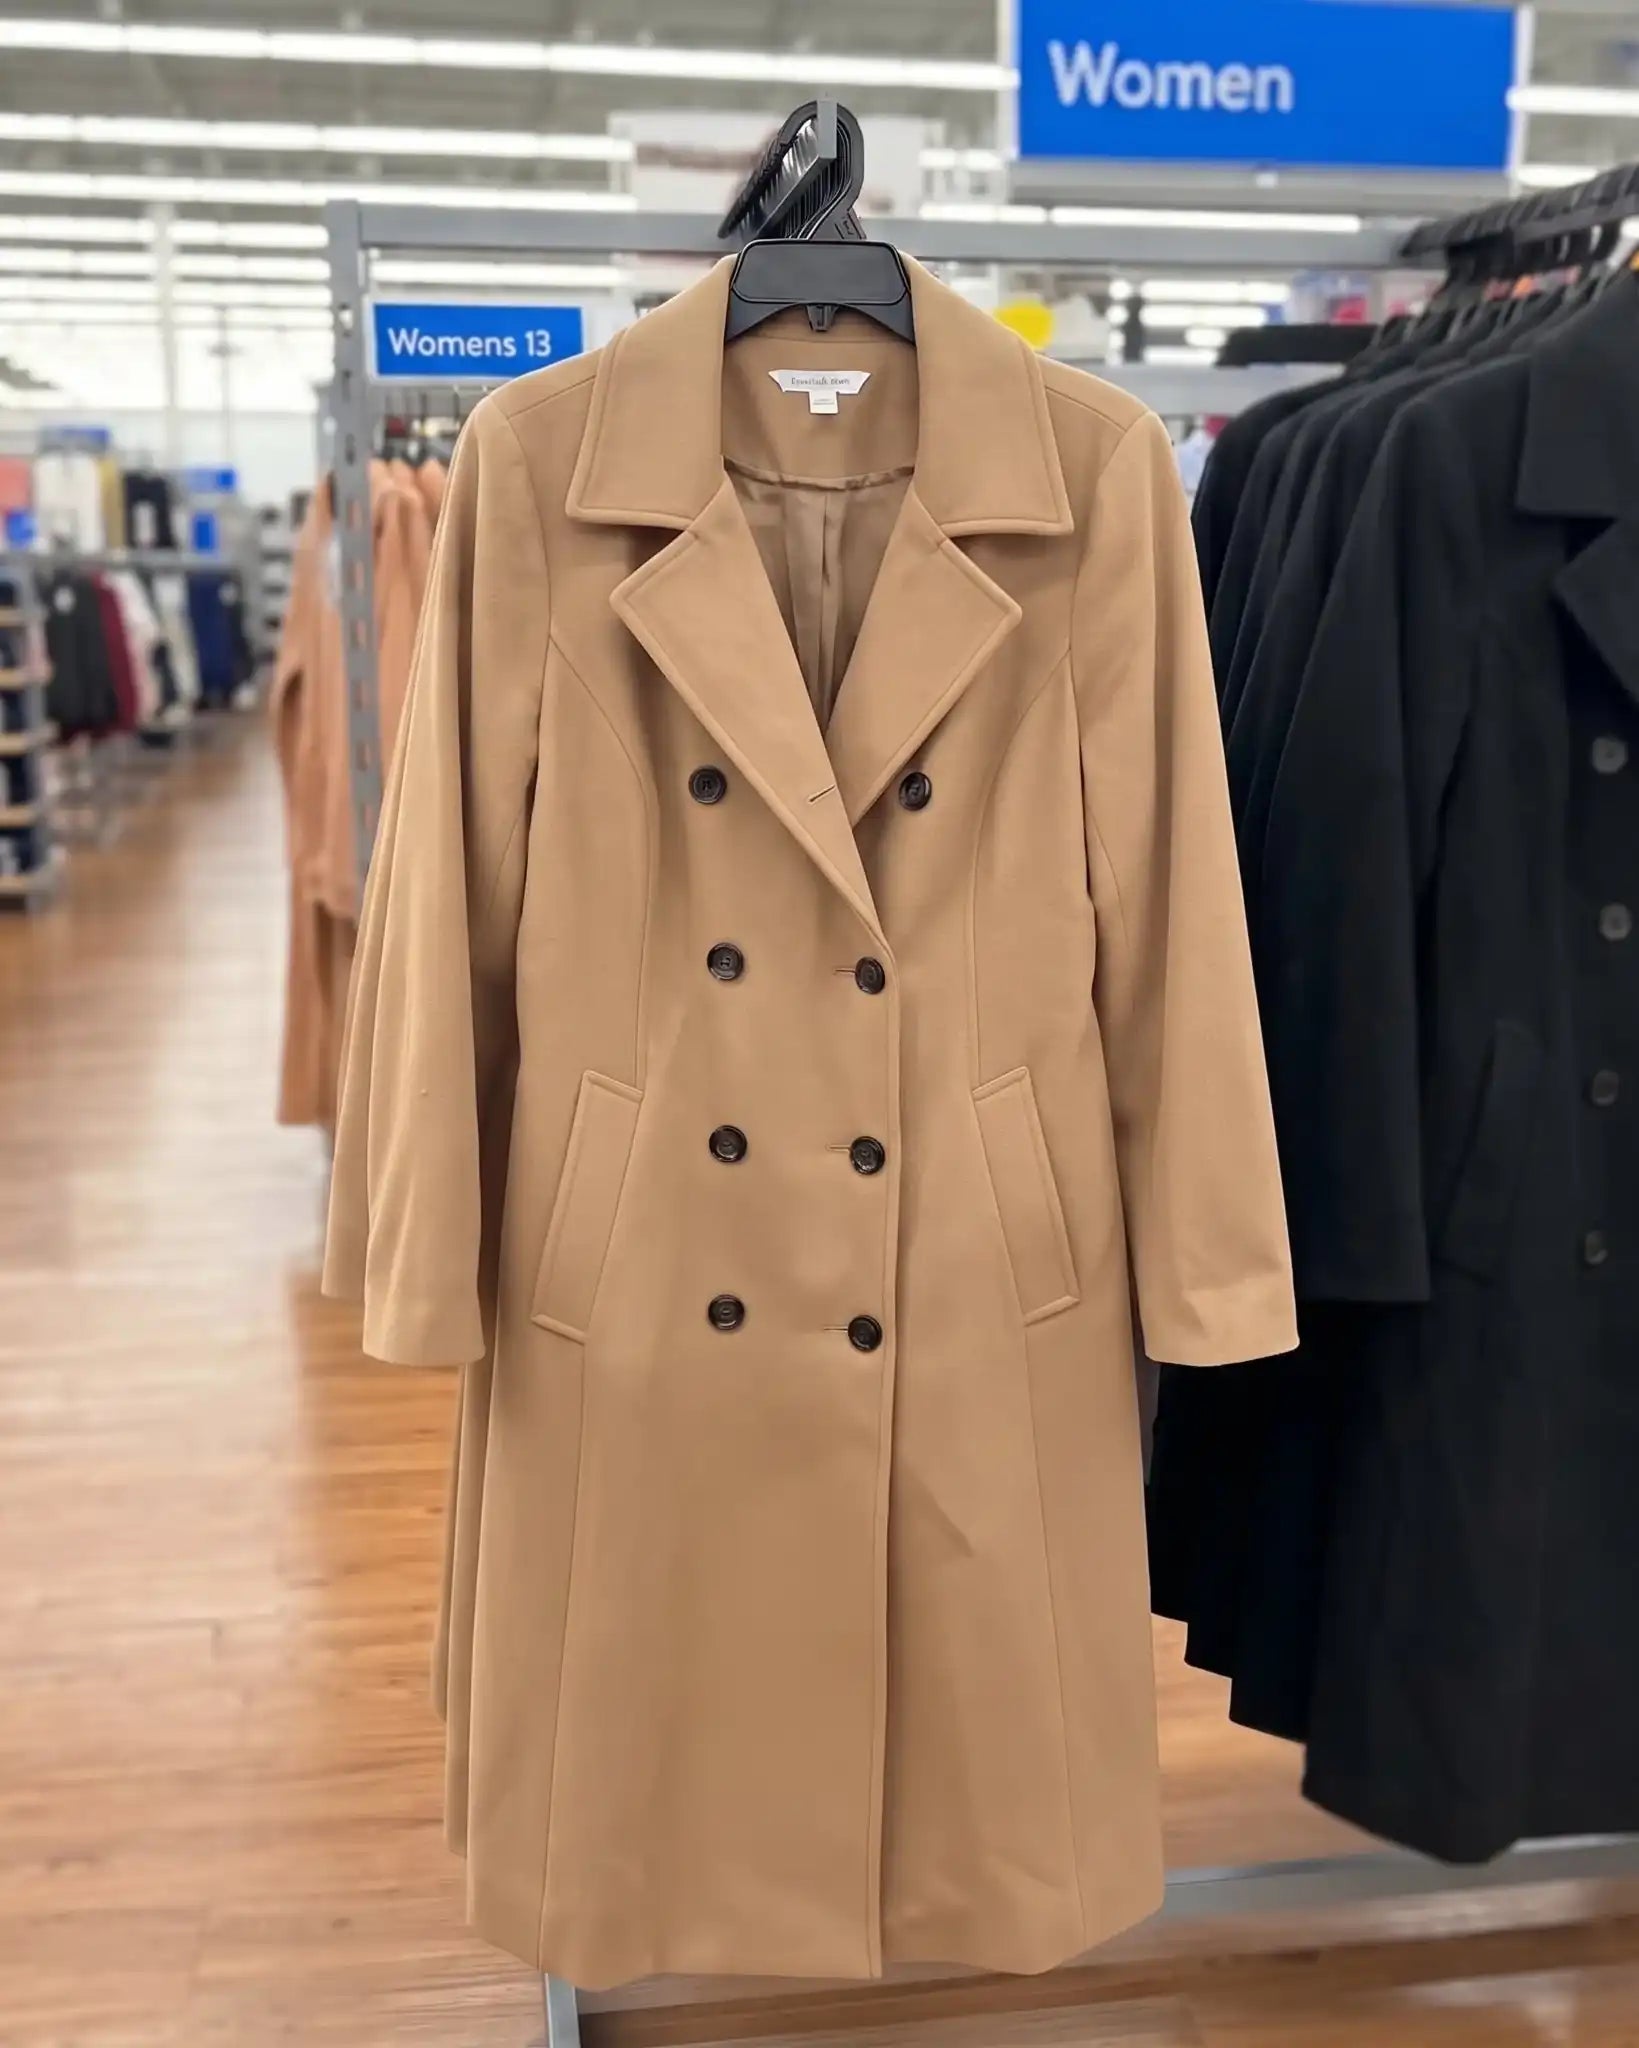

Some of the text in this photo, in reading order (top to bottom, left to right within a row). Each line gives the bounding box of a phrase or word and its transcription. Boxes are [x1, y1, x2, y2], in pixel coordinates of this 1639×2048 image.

[1047, 39, 1294, 114] Women
[387, 327, 552, 358] Womens 13
